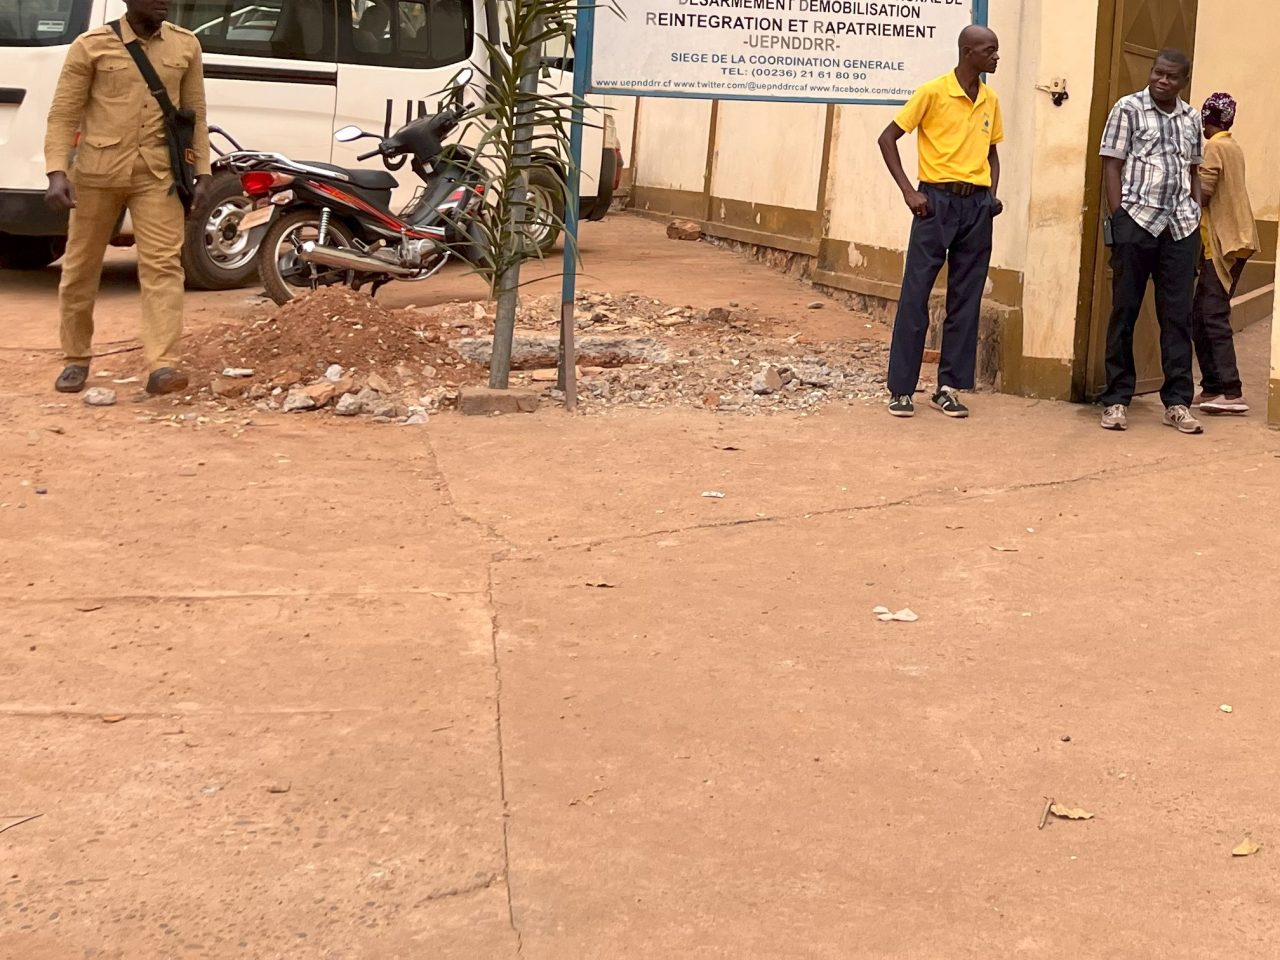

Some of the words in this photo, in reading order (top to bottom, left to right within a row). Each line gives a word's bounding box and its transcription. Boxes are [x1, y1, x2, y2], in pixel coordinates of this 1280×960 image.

[645, 11, 783, 32] REINTEGRATION
[788, 19, 808, 33] ET
[813, 21, 937, 39] RAPATRIEMENT
[743, 34, 841, 52] -UEPNDDRR-
[671, 52, 708, 63] SIEGE
[711, 54, 728, 64] DE
[731, 54, 746, 64] LA
[749, 55, 840, 68] COORDINATION
[843, 59, 905, 71] GENERALE
[720, 67, 748, 76] TEL:
[751, 68, 797, 78] (00236)
[800, 70, 814, 78] 21
[818, 70, 831, 79] 61
[835, 71, 850, 80] 80
[852, 72, 867, 80] 90
